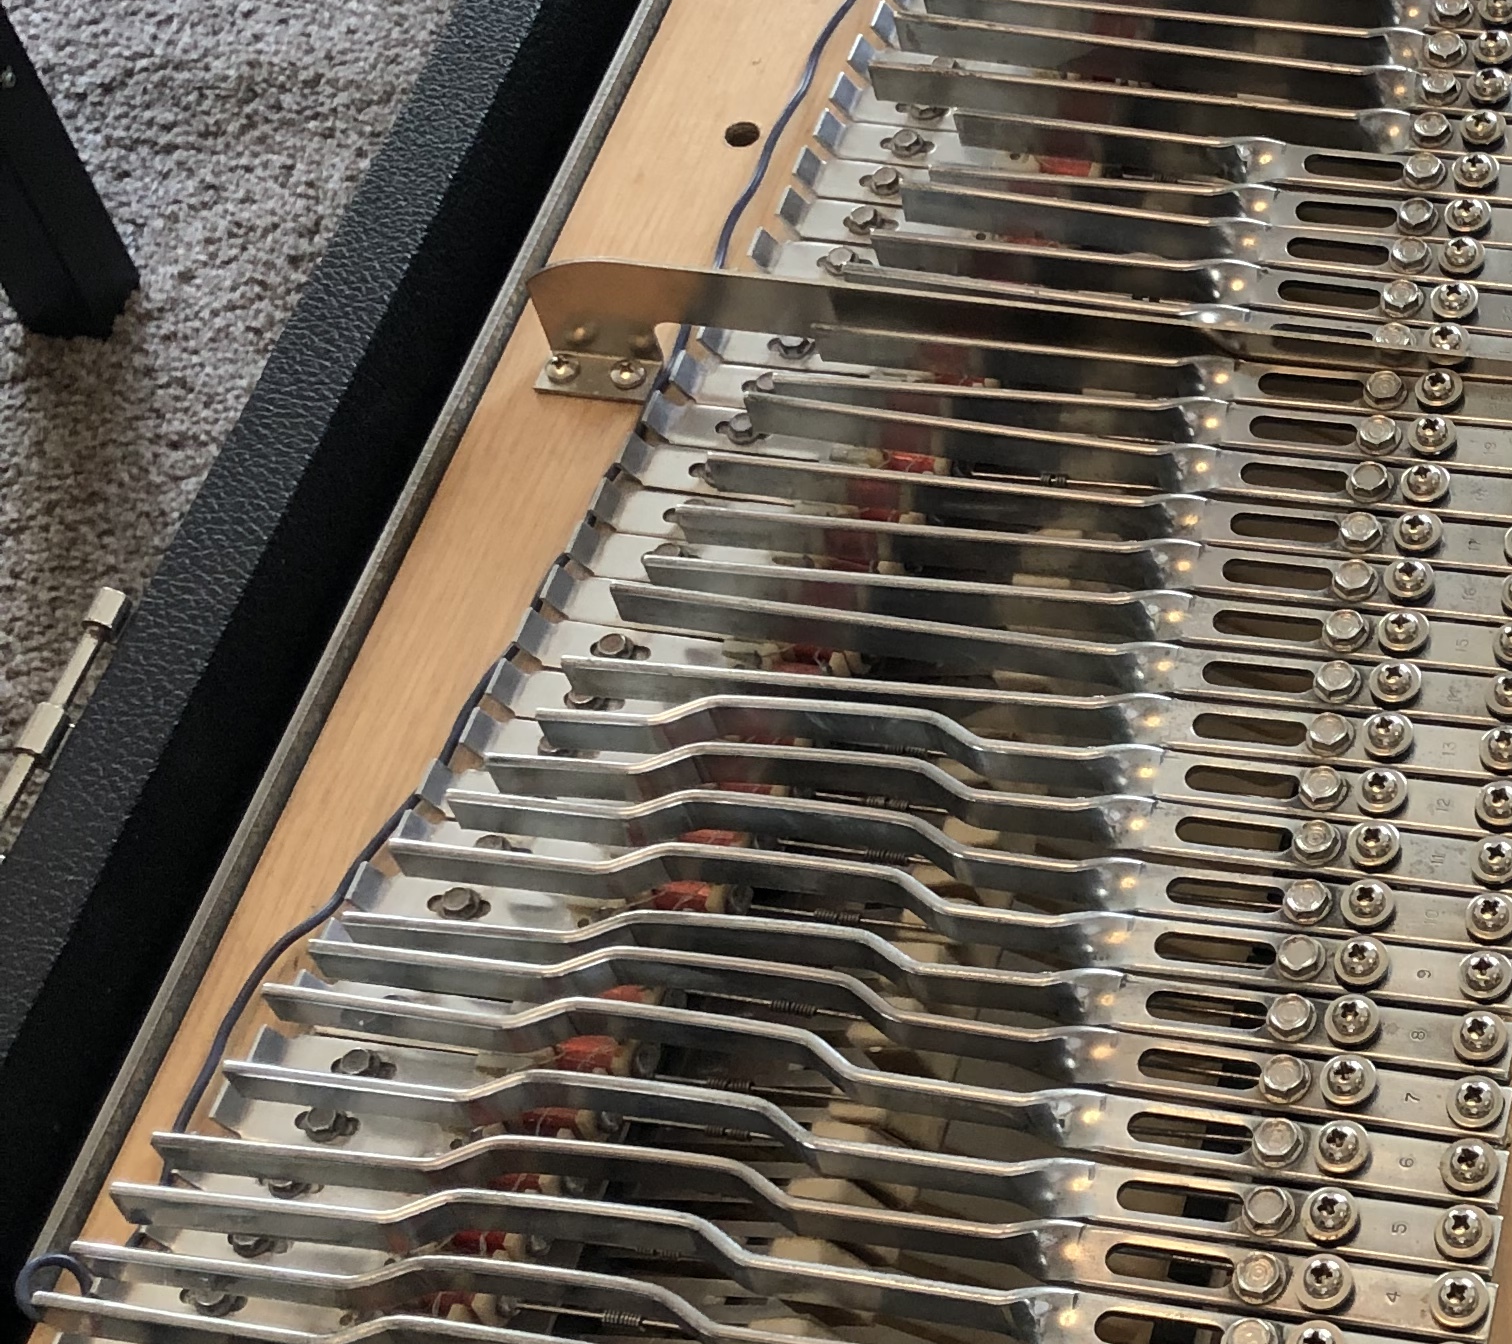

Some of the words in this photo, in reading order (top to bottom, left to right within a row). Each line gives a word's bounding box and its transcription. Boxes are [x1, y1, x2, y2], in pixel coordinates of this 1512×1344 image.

[1417, 969, 1431, 981] 9
[1411, 1029, 1426, 1042] 8
[1405, 1092, 1421, 1104] 7
[1400, 1156, 1414, 1169] 6
[1392, 1223, 1407, 1236] 5
[1386, 1291, 1401, 1303] 4
